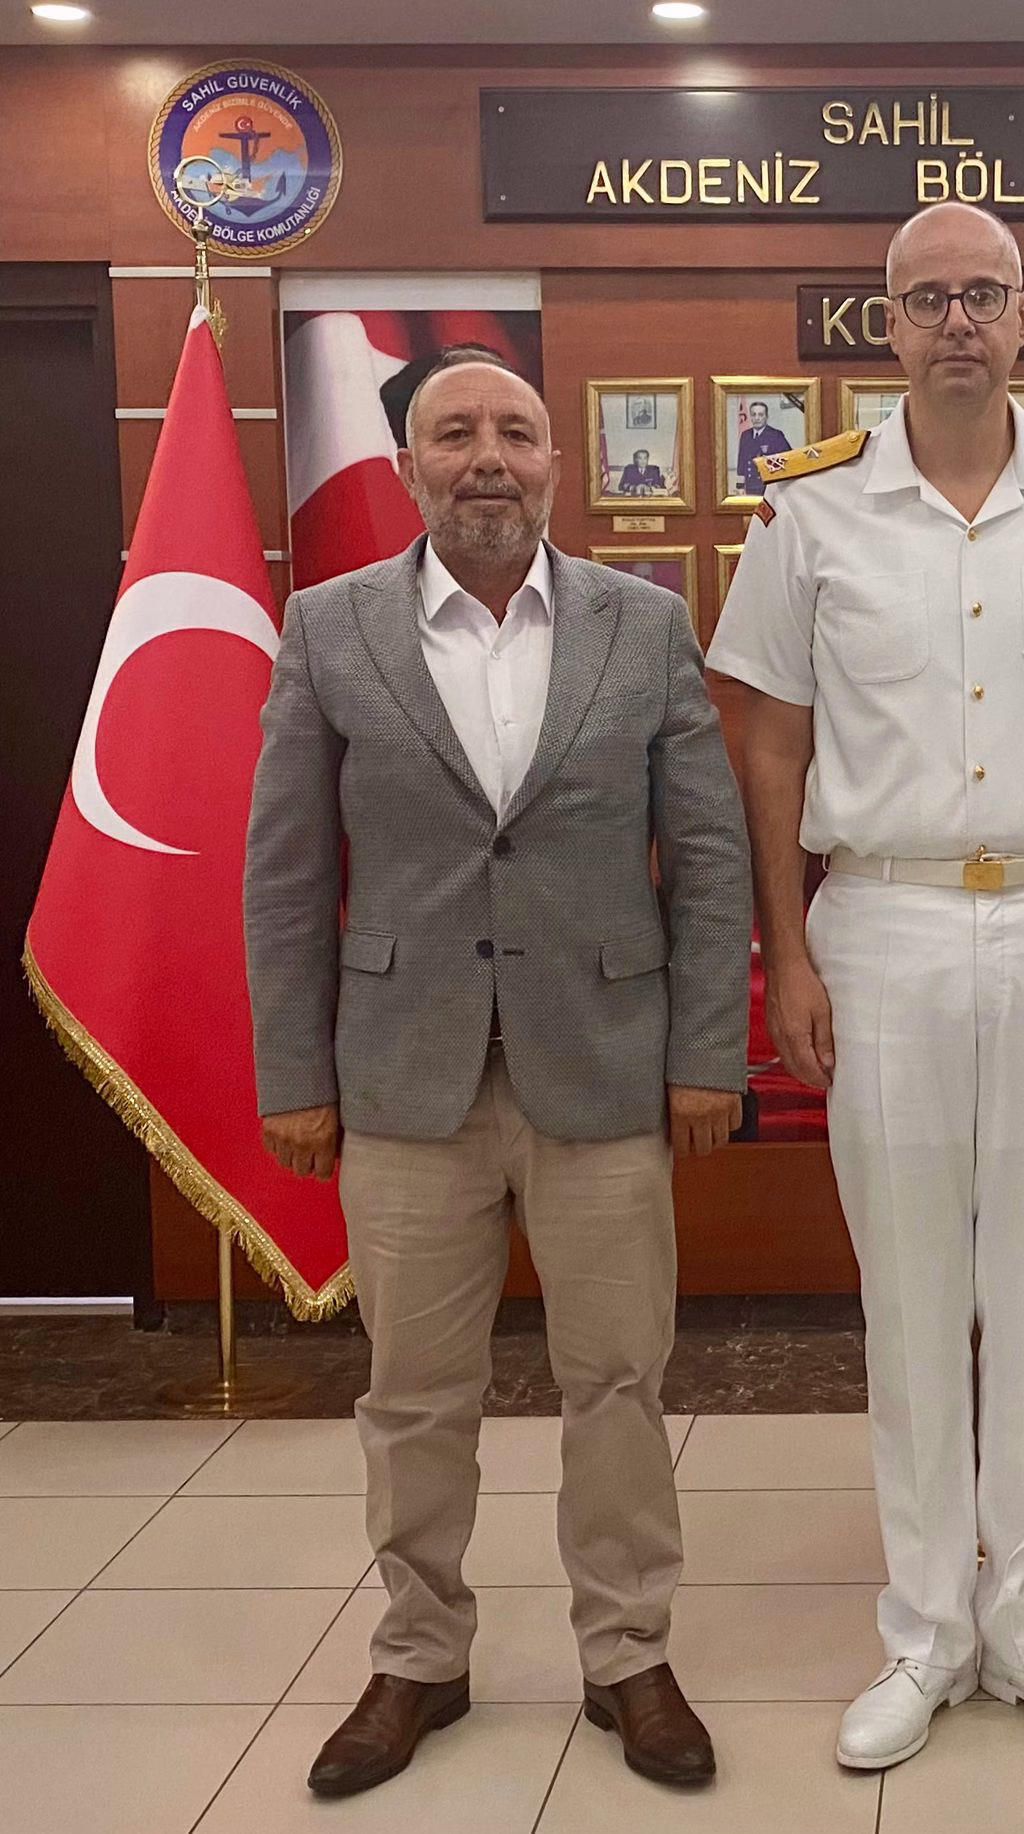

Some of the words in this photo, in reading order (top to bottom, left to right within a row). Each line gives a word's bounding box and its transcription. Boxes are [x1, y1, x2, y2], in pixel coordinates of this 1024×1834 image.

[182, 79, 224, 112] SAHİL
[227, 74, 302, 110] GÜVENLİK
[822, 92, 975, 146] SAHİL
[586, 151, 821, 205] AKDENİZ
[213, 225, 254, 242] BÖLGE
[257, 186, 321, 242] KOMUTANLIĞI
